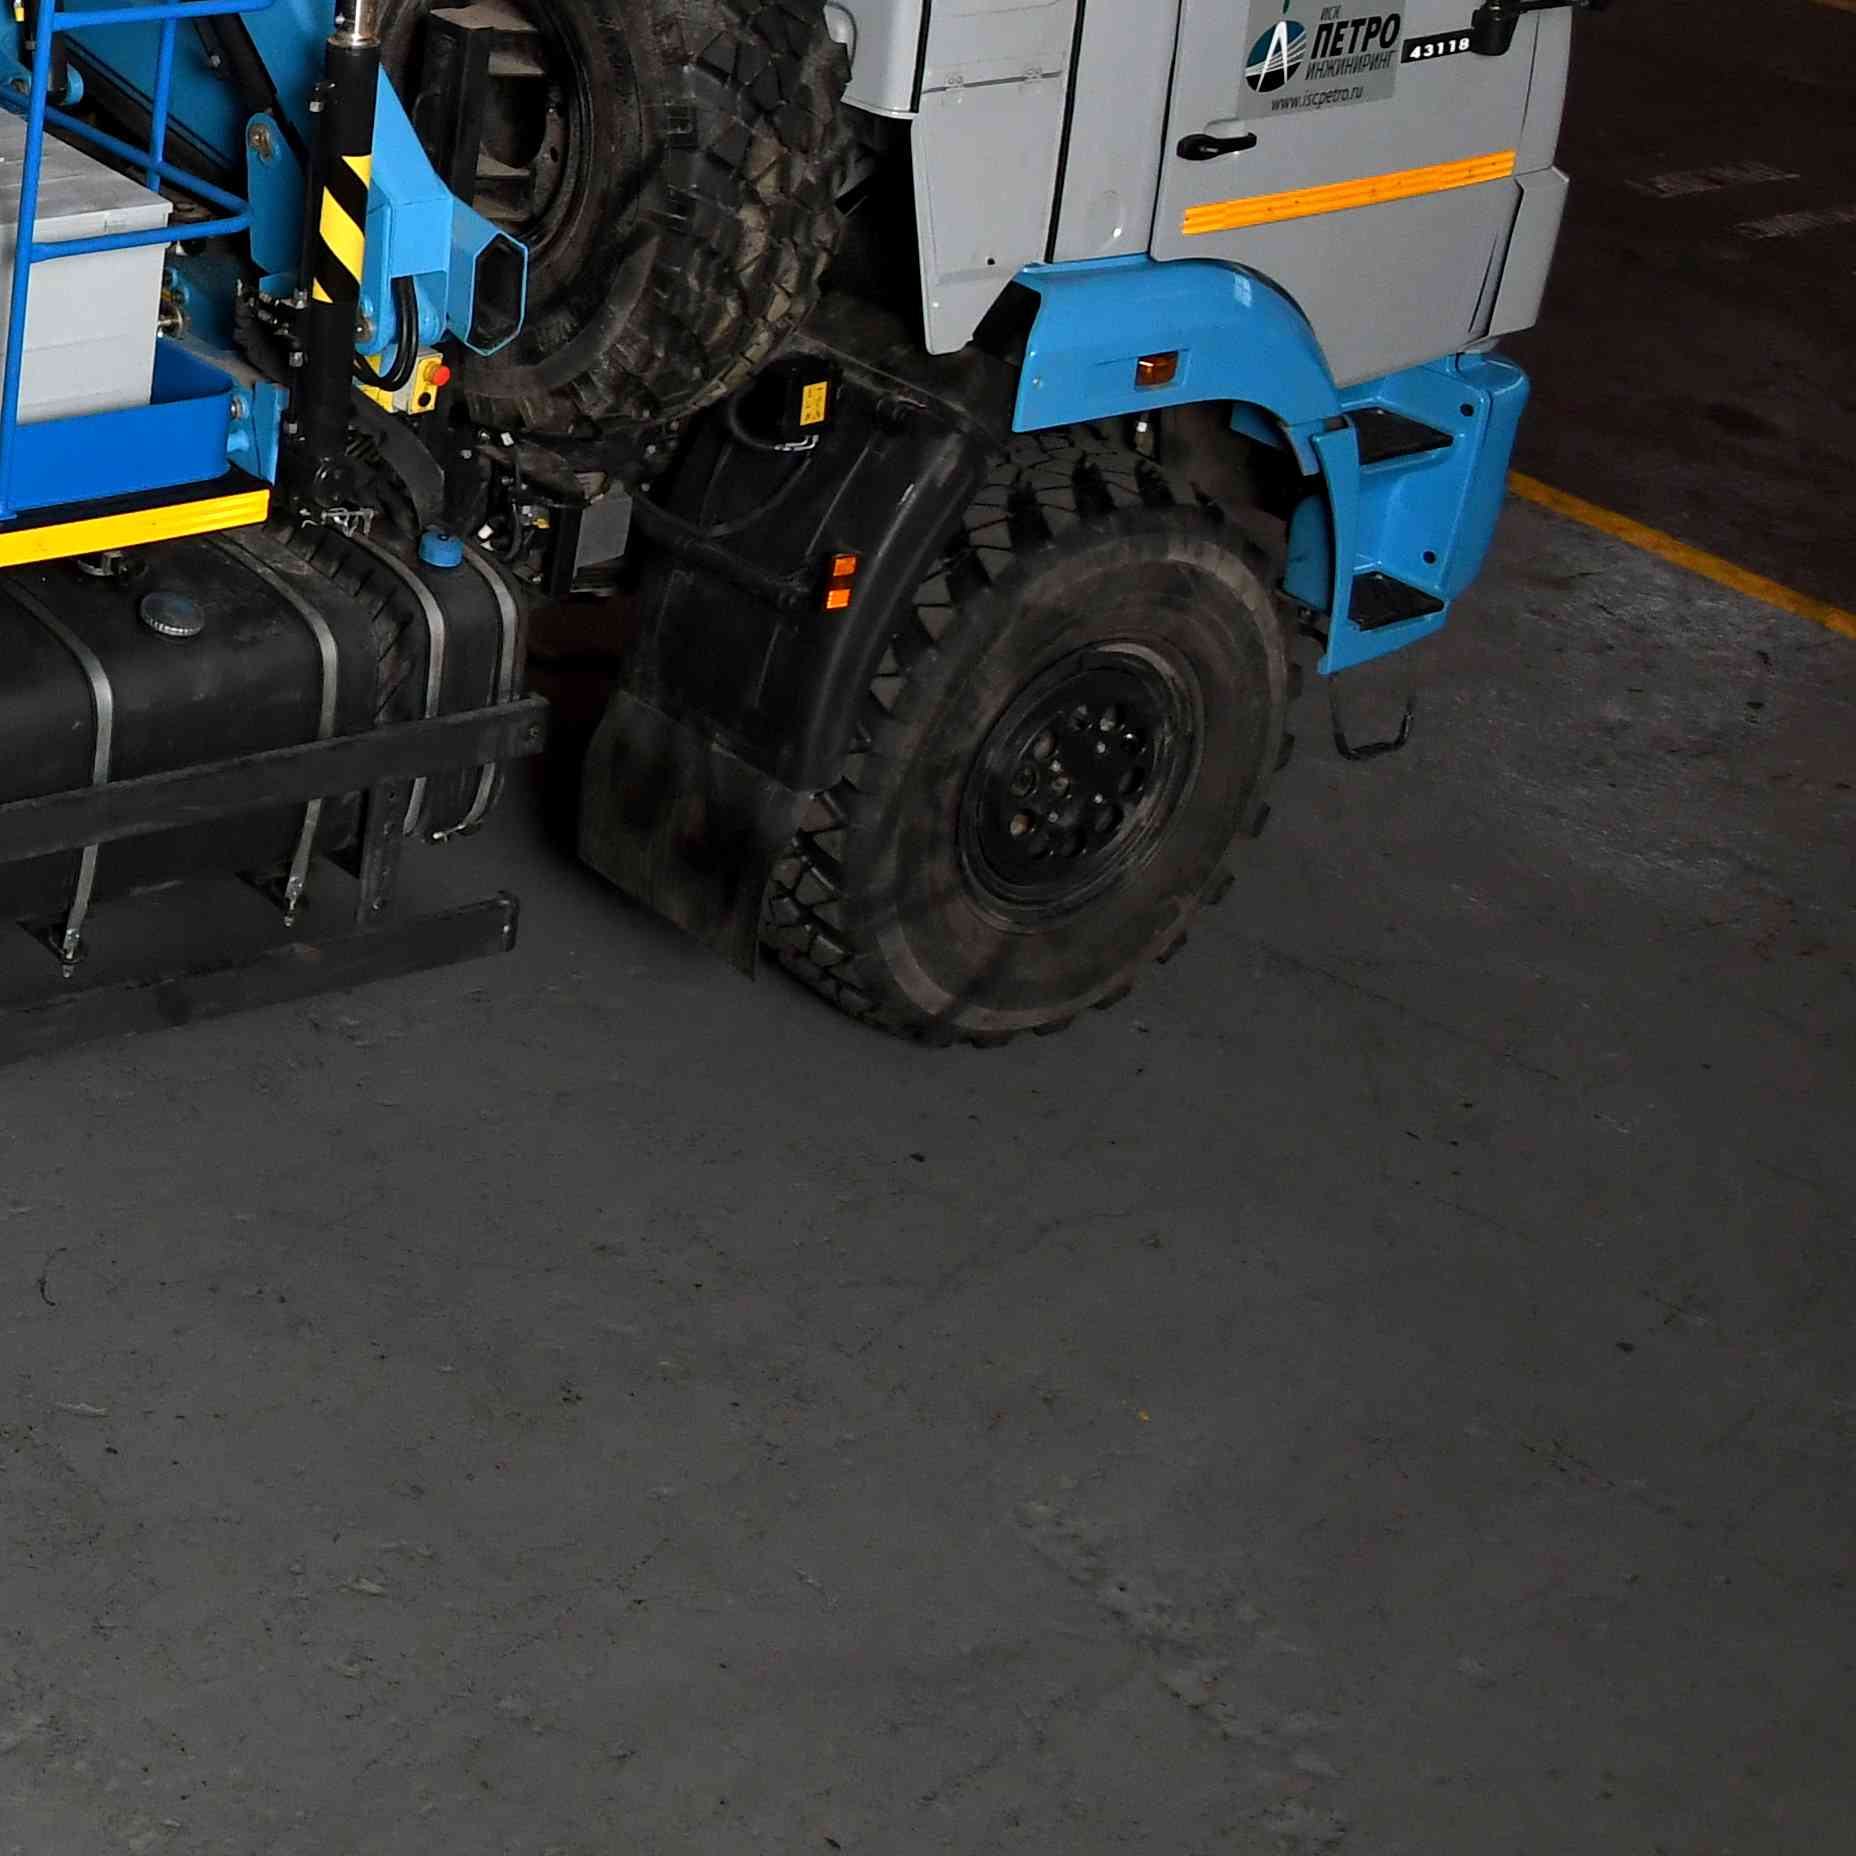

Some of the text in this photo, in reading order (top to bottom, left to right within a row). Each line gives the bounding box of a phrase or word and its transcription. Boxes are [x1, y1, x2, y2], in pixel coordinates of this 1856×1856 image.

[1310, 13, 1401, 60] ПЕТРО
[1409, 37, 1470, 59] 43118
[1304, 50, 1395, 81] ИНЖИНИРИНГ
[1271, 85, 1364, 112] www.iscpetro.ru
